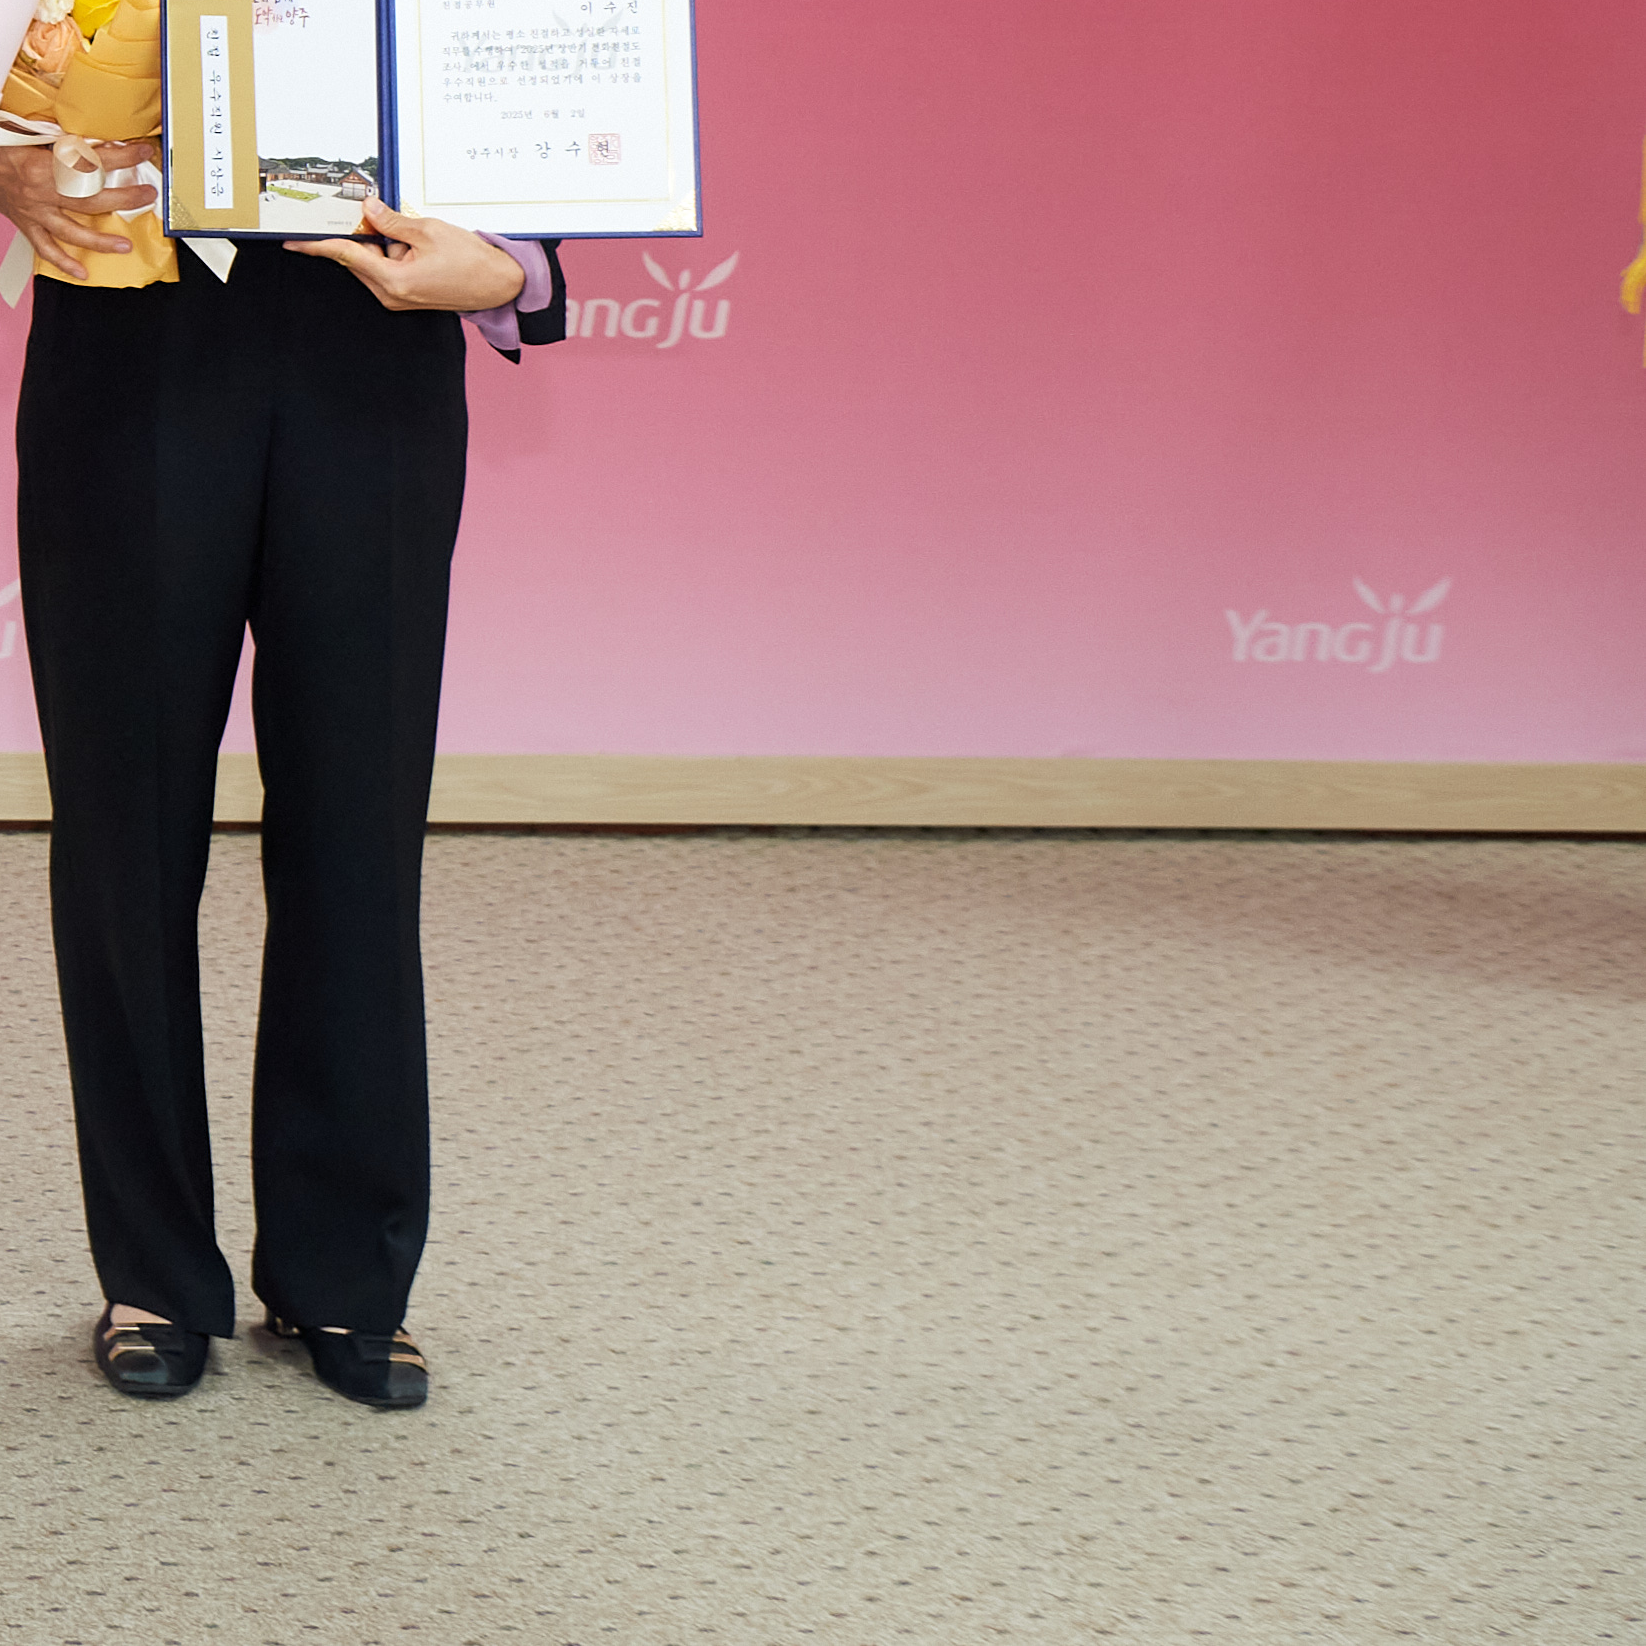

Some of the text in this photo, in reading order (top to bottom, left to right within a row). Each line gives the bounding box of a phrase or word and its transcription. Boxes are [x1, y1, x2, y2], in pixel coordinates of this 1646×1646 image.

[286, 7, 310, 28] 양주
[467, 147, 518, 160] 양주시장
[535, 141, 552, 159] 강
[565, 141, 581, 157] 수
